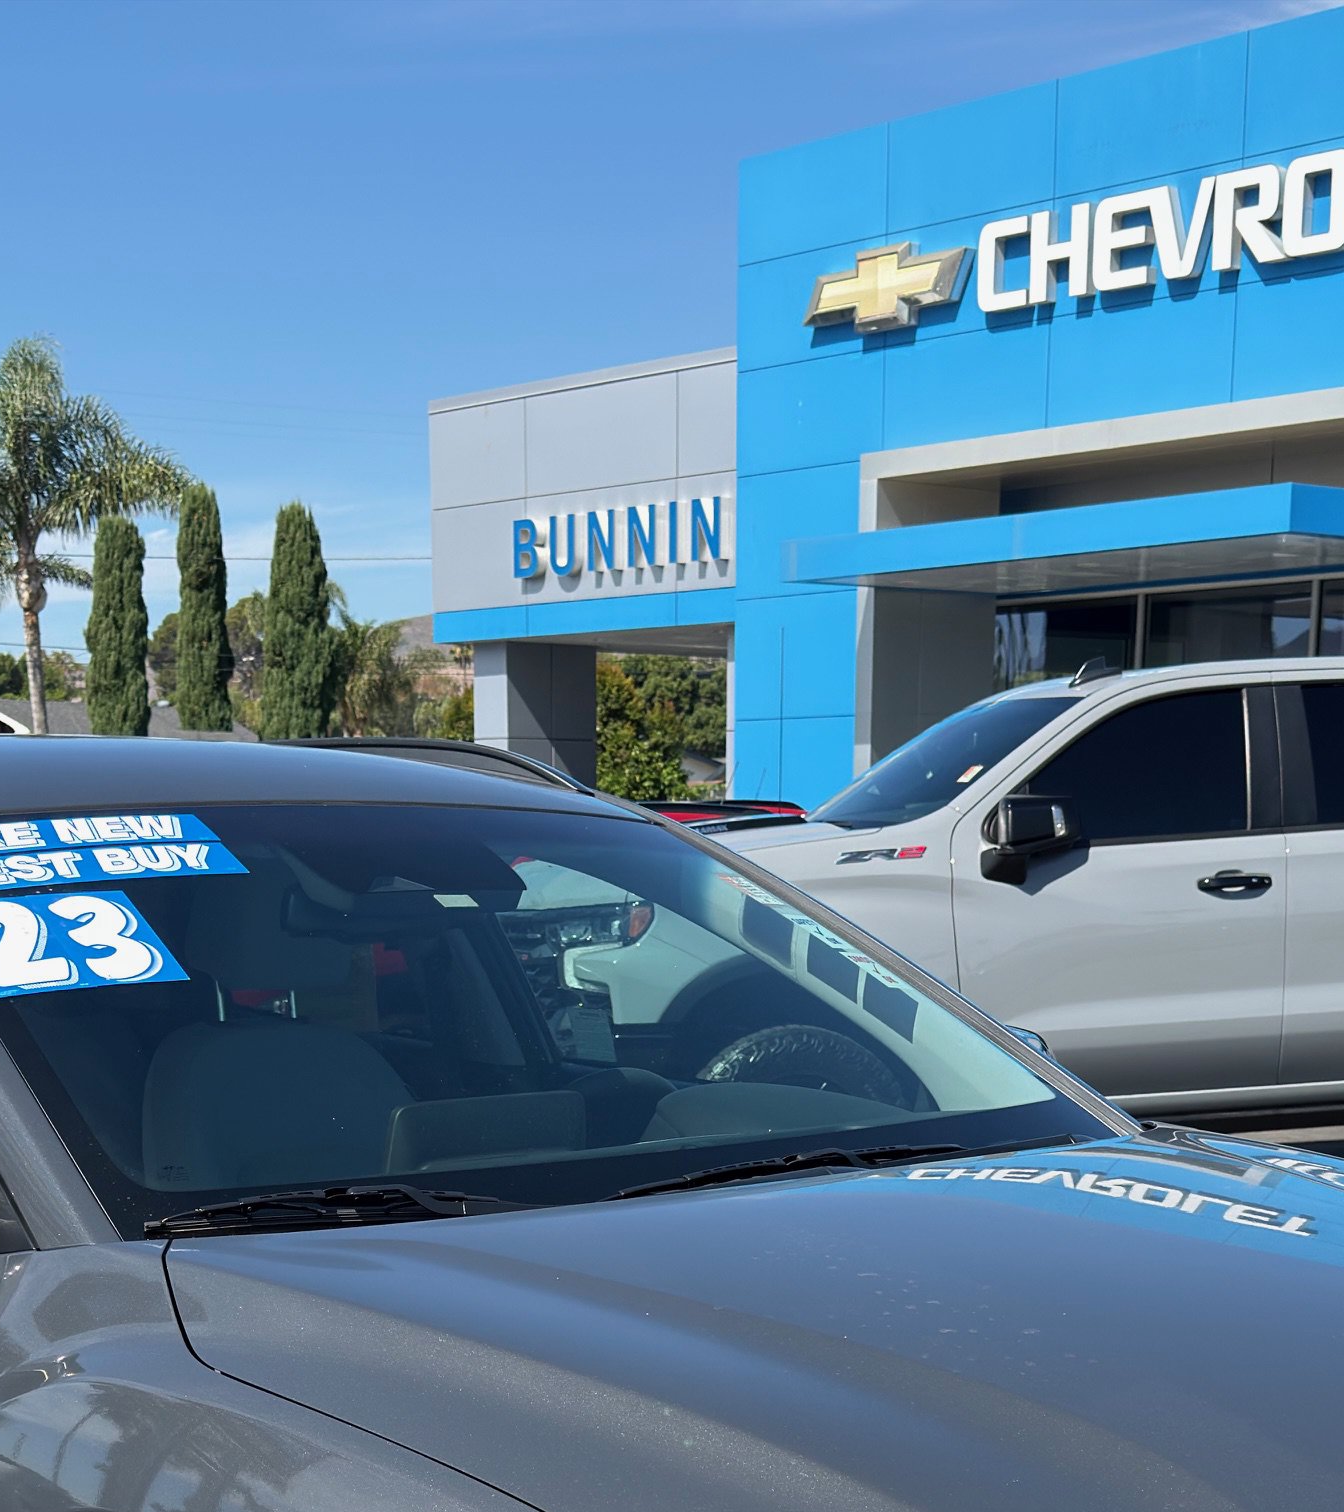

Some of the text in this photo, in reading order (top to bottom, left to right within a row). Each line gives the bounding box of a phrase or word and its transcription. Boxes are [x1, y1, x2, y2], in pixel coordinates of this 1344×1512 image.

[512, 494, 735, 581] BUNNIN
[50, 814, 184, 844] NEW
[92, 844, 210, 875] BUY
[834, 845, 927, 866] ZR2
